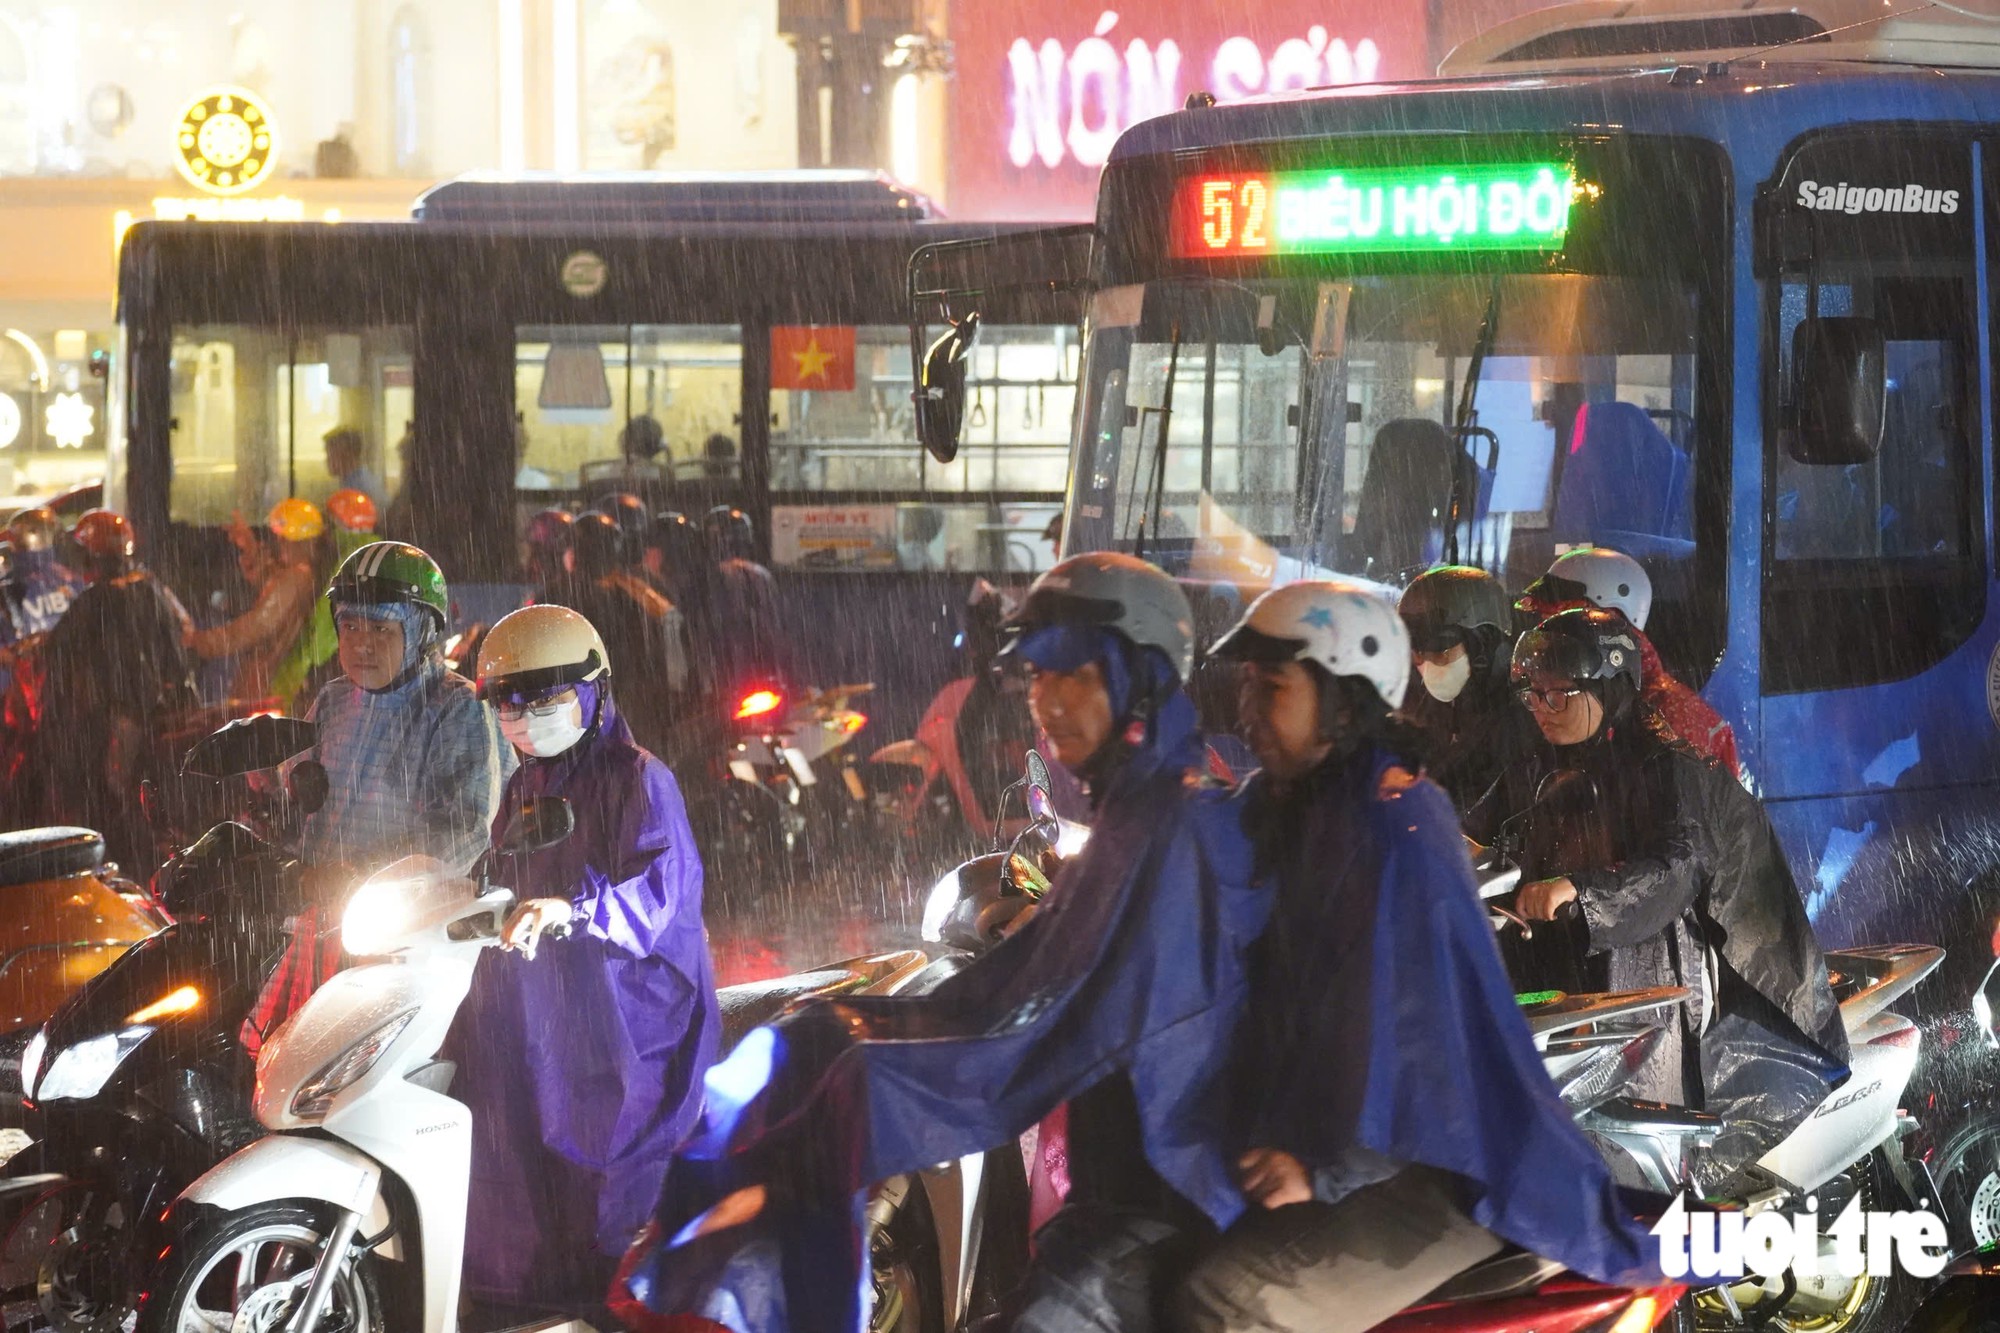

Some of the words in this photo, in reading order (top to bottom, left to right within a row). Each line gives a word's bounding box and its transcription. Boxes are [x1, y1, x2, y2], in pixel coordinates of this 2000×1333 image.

[1008, 10, 1181, 168] NÓN
[1203, 179, 1267, 248] 52
[1797, 180, 1960, 215] SaigonBus
[415, 1121, 459, 1135] HONDA
